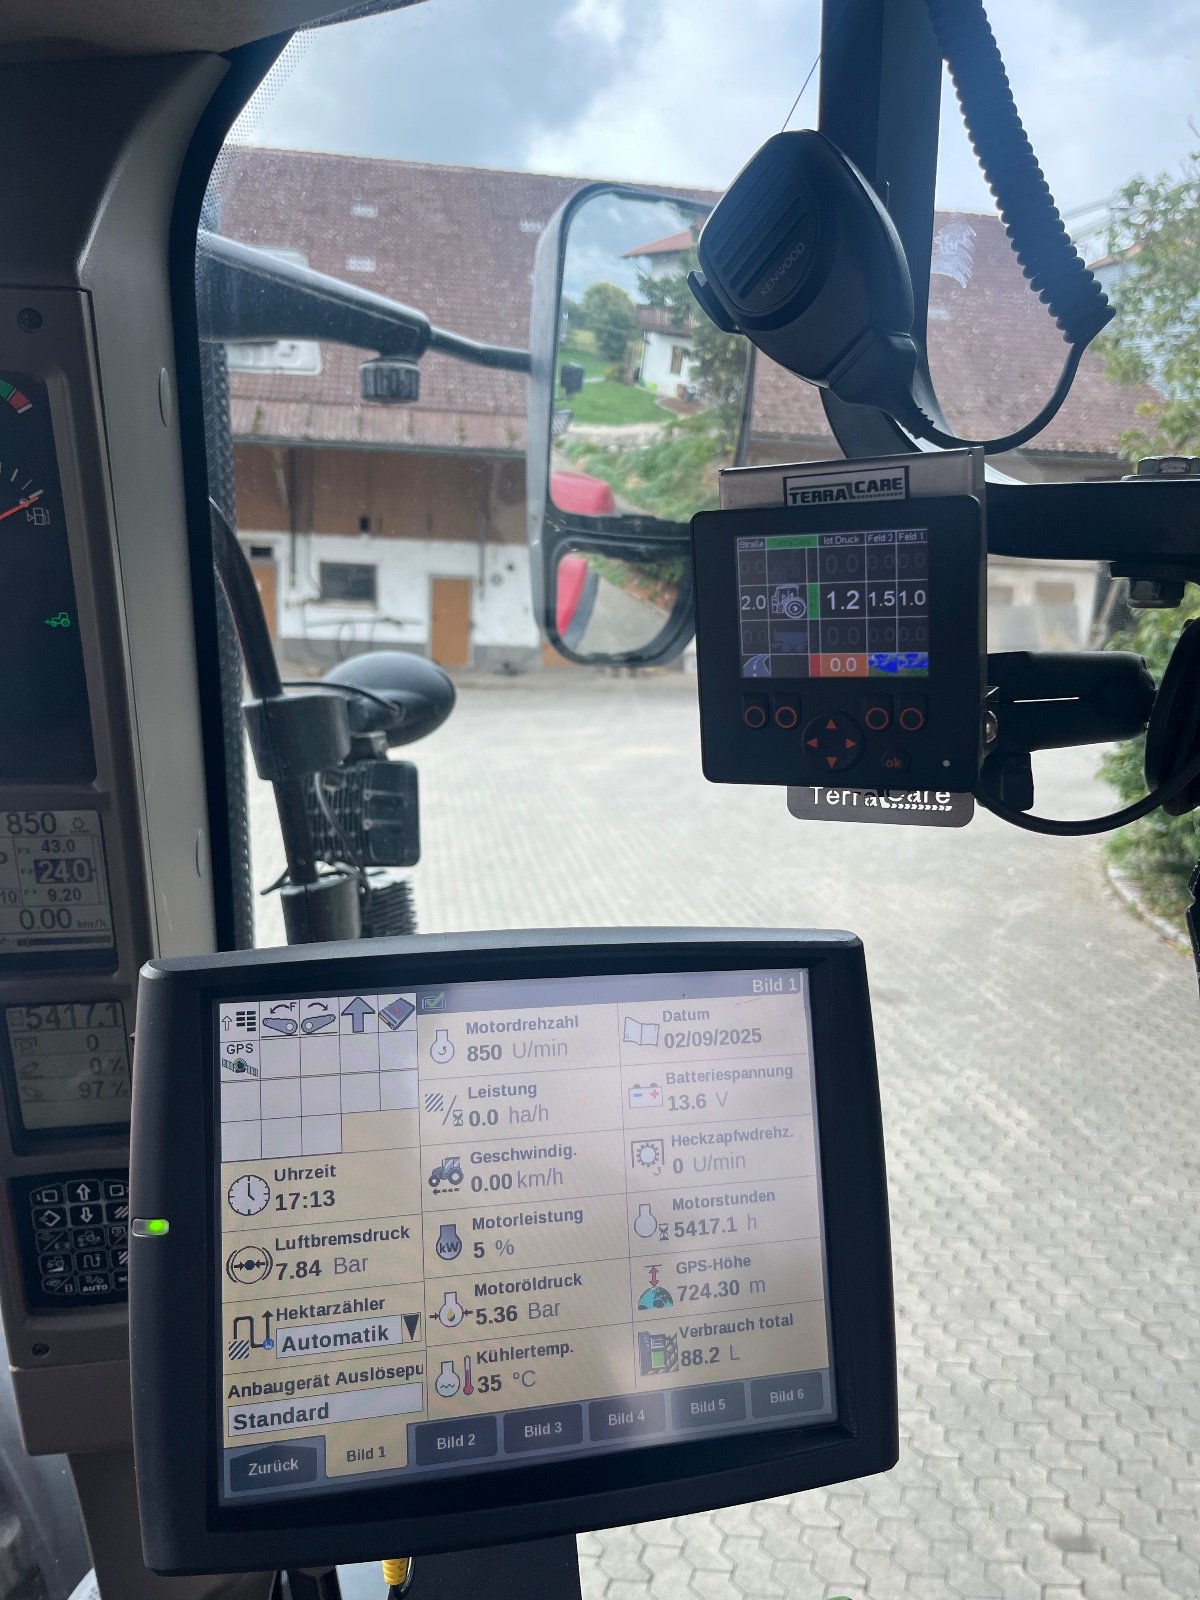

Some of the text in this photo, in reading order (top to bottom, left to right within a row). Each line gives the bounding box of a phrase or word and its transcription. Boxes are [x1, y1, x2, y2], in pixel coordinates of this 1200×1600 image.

[760, 242, 805, 298] KENWOOD
[789, 477, 903, 505] TERRA CARE
[739, 540, 764, 549] Straße
[823, 535, 859, 545] Ist Druck
[867, 533, 893, 543] Feld 2
[899, 533, 917, 541] Feld
[741, 595, 766, 610] 2.0
[826, 589, 860, 610] 1.2
[868, 590, 895, 607] 1.5
[898, 589, 926, 606] 1.0
[830, 657, 857, 672] 0.0
[885, 756, 902, 768] ok
[6, 812, 57, 835] 850
[41, 839, 76, 853] 43.0
[48, 887, 82, 902] 9.20
[19, 907, 72, 930] 0.00
[752, 977, 798, 993] Bild 1
[25, 1003, 119, 1029] 5417.1
[466, 1014, 579, 1035] Motordrehzahl
[662, 1009, 710, 1023] Datum
[664, 1027, 762, 1049] 02/09/2025
[226, 1043, 254, 1055] GPS
[467, 1039, 568, 1062] 850 U/min
[666, 1066, 793, 1085] Batteriespannung
[79, 1080, 104, 1100] 97
[468, 1084, 537, 1100] Leistung
[668, 1091, 728, 1112] 13.6 V
[469, 1104, 549, 1127] 0.0 ha/h
[671, 1126, 794, 1148] Heckzapfwdrehz.
[470, 1144, 577, 1164] Geschwindig.
[672, 1153, 746, 1174] 0 U/min
[274, 1164, 336, 1182] Uhrzeit
[471, 1167, 564, 1193] 0.00 km/h
[275, 1189, 336, 1211] 17:13
[672, 1190, 776, 1211] Motorstunden
[472, 1209, 584, 1231] Motorleistung
[674, 1214, 758, 1238] 5417.1 h
[275, 1225, 410, 1251] Luftbremsdruck
[439, 1242, 459, 1254] kW
[473, 1239, 515, 1259] 5 %
[276, 1257, 368, 1281] 7.84 Bar
[676, 1255, 752, 1275] GPS-Höhe
[82, 1283, 109, 1293] AUTO
[474, 1273, 583, 1297] Motoröldruck
[677, 1279, 766, 1302] 724.30 m
[276, 1298, 385, 1321] Hektarzähler
[475, 1302, 560, 1325] 5.36 Bar
[679, 1313, 793, 1339] Verbrauch total
[281, 1325, 390, 1352] Automatik
[477, 1342, 574, 1365] Kühlertemp.
[681, 1345, 740, 1367] 88.2 L
[228, 1363, 424, 1399] Anbaugerät Auslösepu
[477, 1370, 536, 1394] 35 °C
[690, 1398, 726, 1415] Bild 5
[770, 1388, 804, 1404] Bild 6
[233, 1402, 329, 1431] Standard
[608, 1409, 646, 1426] Bild 4
[524, 1421, 562, 1437] Bild 3
[437, 1433, 476, 1450] Bild 2
[346, 1445, 386, 1462] Bild 1
[248, 1457, 299, 1476] Zurück
